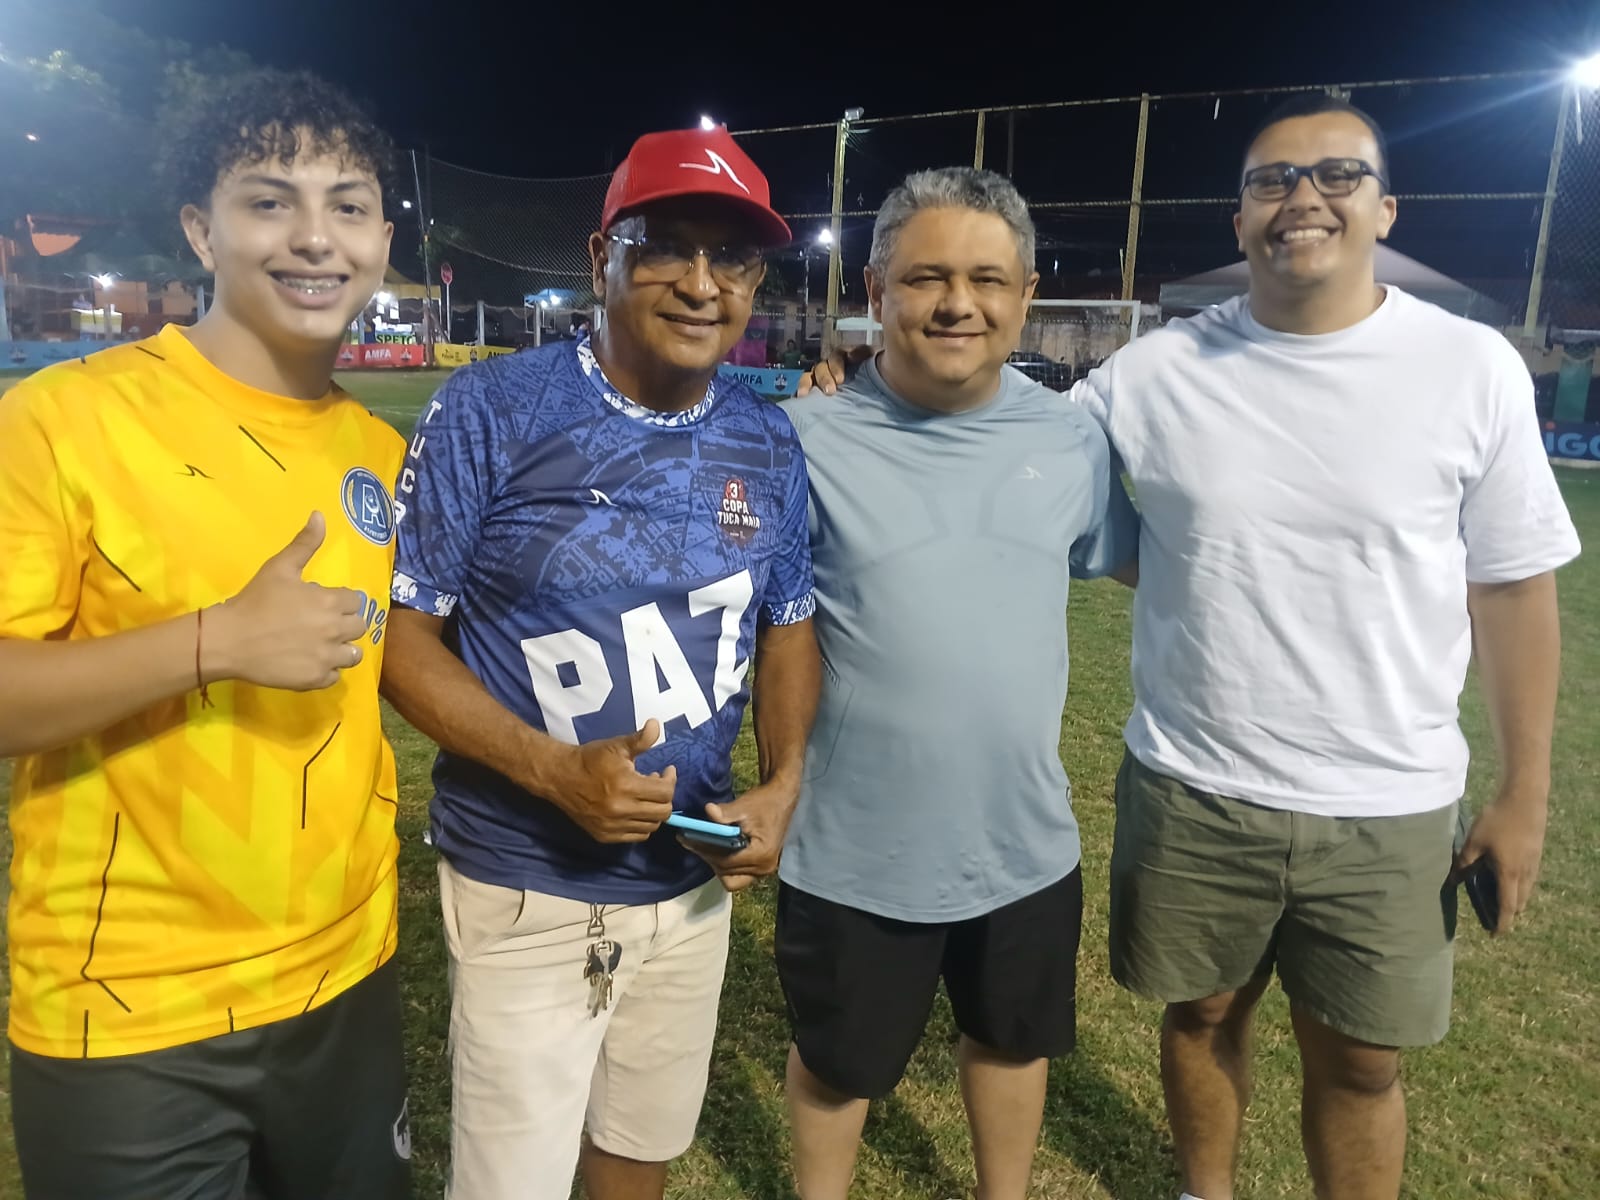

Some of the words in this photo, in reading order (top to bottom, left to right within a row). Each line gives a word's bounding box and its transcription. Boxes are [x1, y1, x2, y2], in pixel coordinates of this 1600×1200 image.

[364, 349, 392, 361] AMFA
[732, 372, 763, 385] AMFA
[722, 499, 750, 515] COPA
[717, 511, 740, 526] TUCA
[741, 513, 760, 529] MAIA
